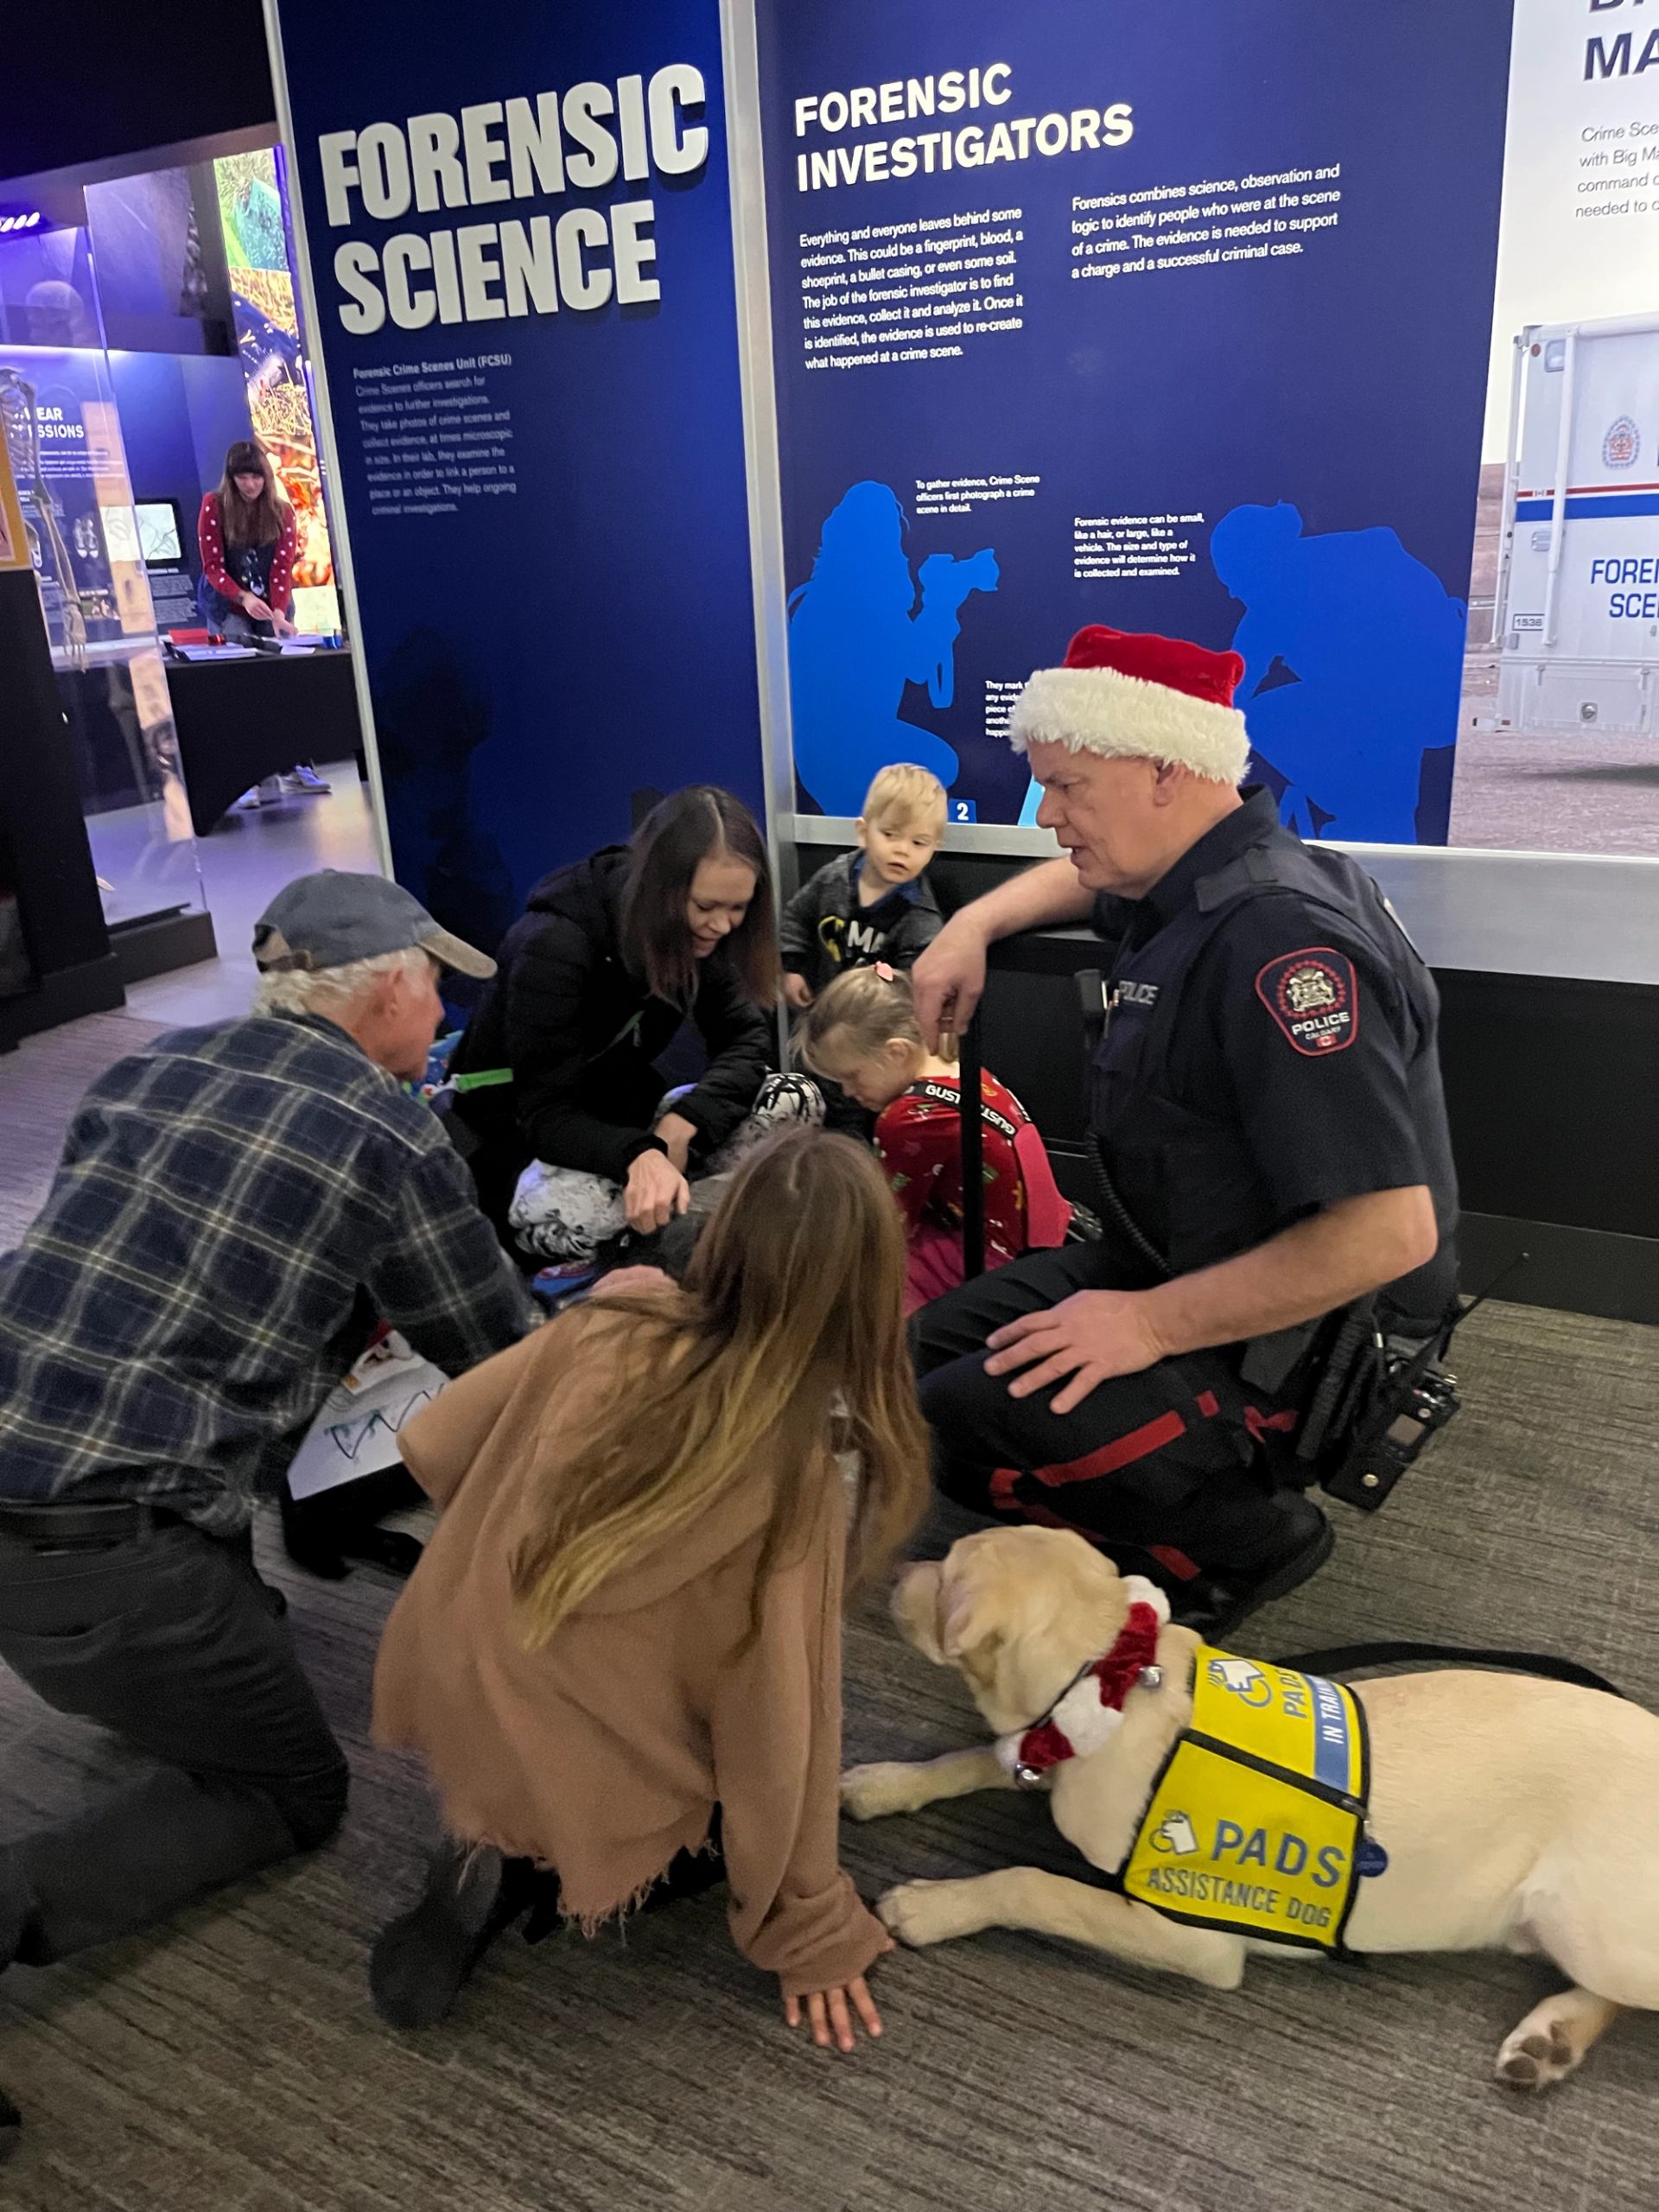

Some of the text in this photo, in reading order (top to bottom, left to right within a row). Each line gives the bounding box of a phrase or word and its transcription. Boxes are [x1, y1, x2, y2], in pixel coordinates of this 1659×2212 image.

[795, 63, 1013, 137] FORENSIC
[318, 64, 709, 227] FORENSIC
[797, 104, 1134, 192] INVESTIGATORS
[1581, 125, 1624, 143] Crime
[1580, 149, 1637, 168] with Big
[1073, 163, 1339, 211] Forensics combines science, observation and
[1577, 171, 1649, 193] command
[1072, 191, 1340, 236] logic to identify people who were at the scene
[1576, 200, 1648, 218] needed to
[800, 209, 1021, 248] Everything and everyone leaves behind some
[1071, 213, 1338, 256] of a crime. The evidence is needed to support
[801, 229, 1023, 268] evidence. This could be a fingerprint, blood, a
[1071, 243, 1303, 278] a charge and a successful criminal case.
[334, 200, 660, 334] SCIENCE
[802, 251, 1016, 289] shoeprint, a bullet casing, or even some soil.
[802, 273, 1014, 310] The job of the forensic investigator is to find
[804, 294, 1023, 329] this evidence, collect it and analyze it. Once it
[804, 318, 1022, 349] is identified, the evidence is used to re-create
[805, 346, 963, 369] what happened at a crime scene.
[916, 480, 925, 489] To
[926, 480, 950, 491] gather
[988, 476, 1013, 486] Crime
[1014, 475, 1039, 484] Scene
[961, 489, 1004, 501] photograph
[1013, 488, 1035, 497] crime
[949, 503, 971, 512] detail.
[1075, 517, 1109, 526] Forensic
[1110, 517, 1147, 525] evidence
[1166, 514, 1178, 523] be
[1074, 556, 1110, 565] evidence
[1127, 554, 1168, 563] determine
[1190, 553, 1196, 562] it
[1106, 543, 1122, 551] The
[1141, 541, 1157, 550] and
[1159, 542, 1177, 551] type
[1179, 540, 1187, 549] of
[1074, 567, 1179, 577] is collected and examined.
[1591, 558, 1659, 584] FORE
[957, 802, 969, 821] 2
[1291, 1012, 1350, 1035] POLICE
[1322, 1726, 1344, 1744] IN
[1211, 1819, 1346, 1888] PADS
[1147, 1866, 1332, 1928] ASSISTANCE DOG
